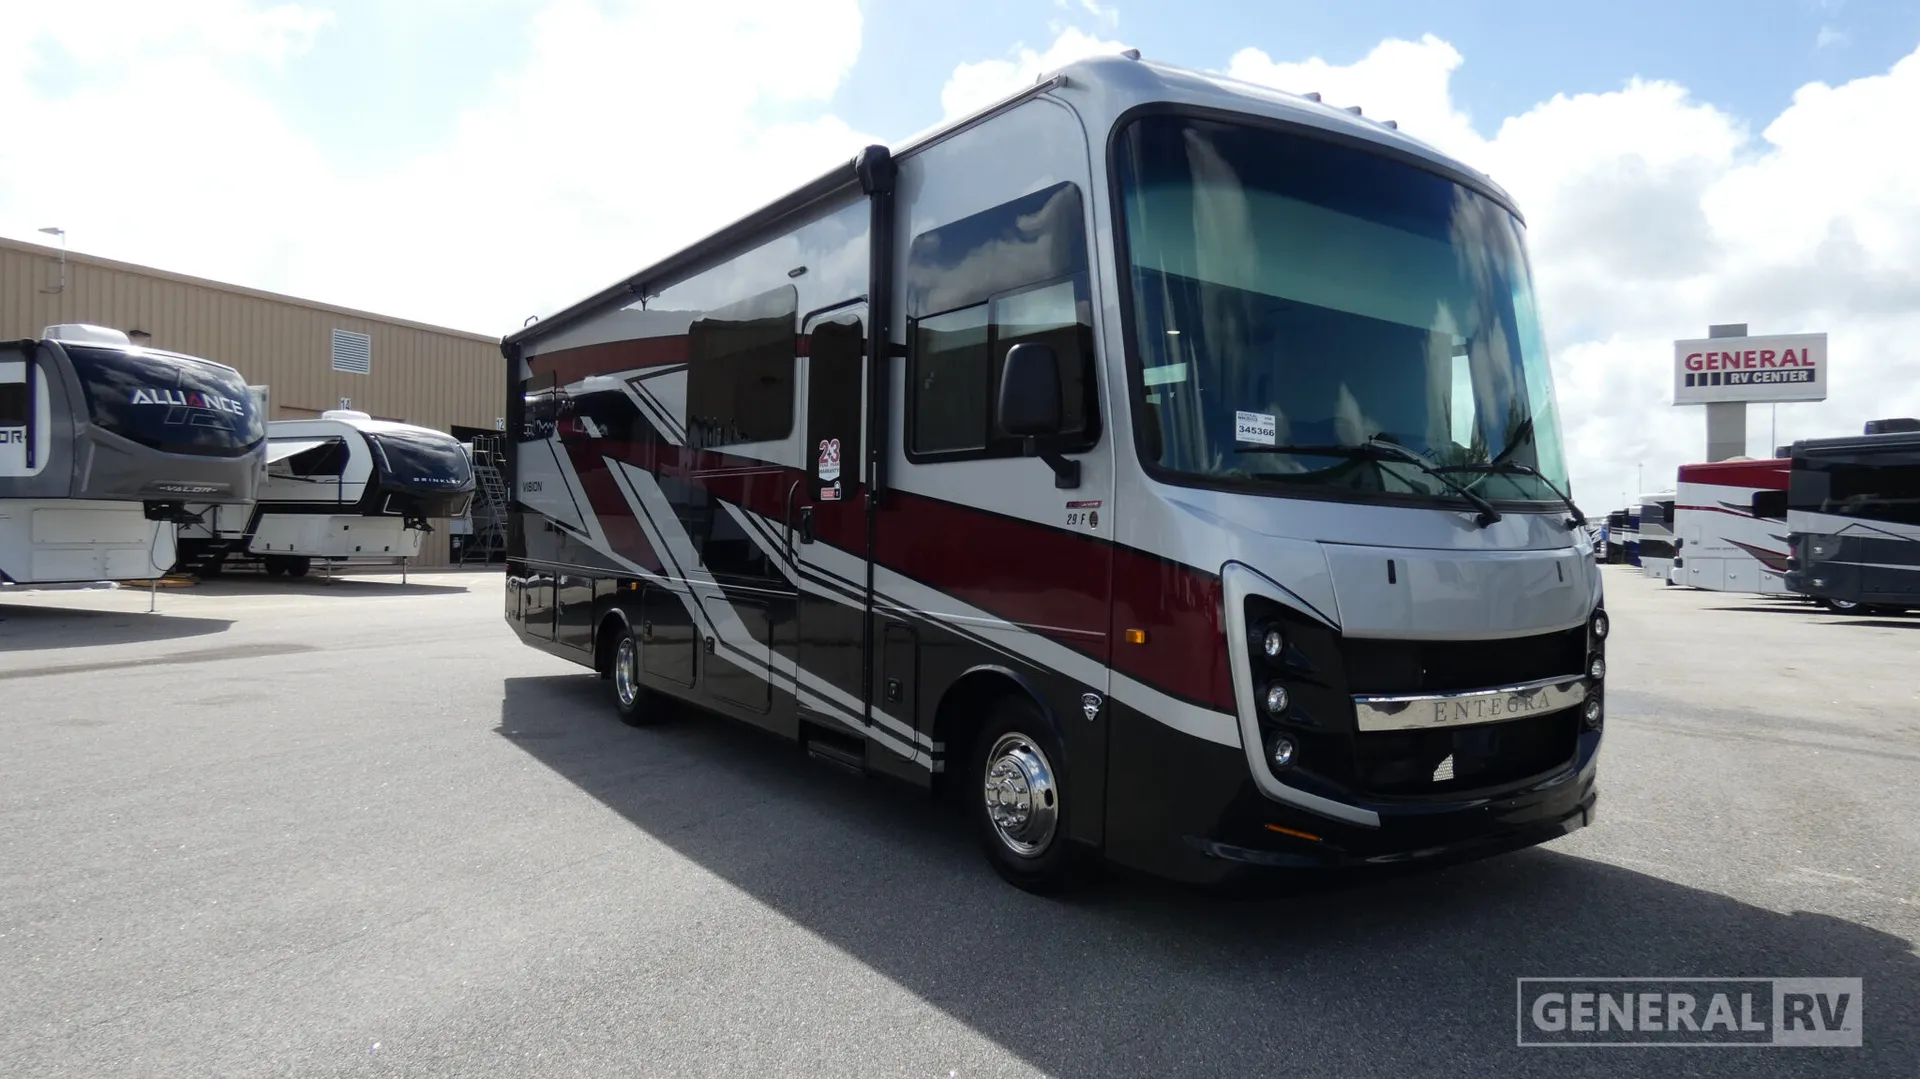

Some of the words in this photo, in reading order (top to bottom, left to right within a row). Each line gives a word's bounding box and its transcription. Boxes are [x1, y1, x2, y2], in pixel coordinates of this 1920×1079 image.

[1684, 348, 1816, 372] GENERAL
[1730, 372, 1750, 384] RV
[1752, 370, 1808, 383] CENTER
[132, 388, 245, 416] ALLIANCE
[1238, 425, 1275, 437] 345366
[1066, 513, 1078, 525] 29
[1080, 513, 1086, 525] F
[1433, 691, 1551, 723] ENTEGRA
